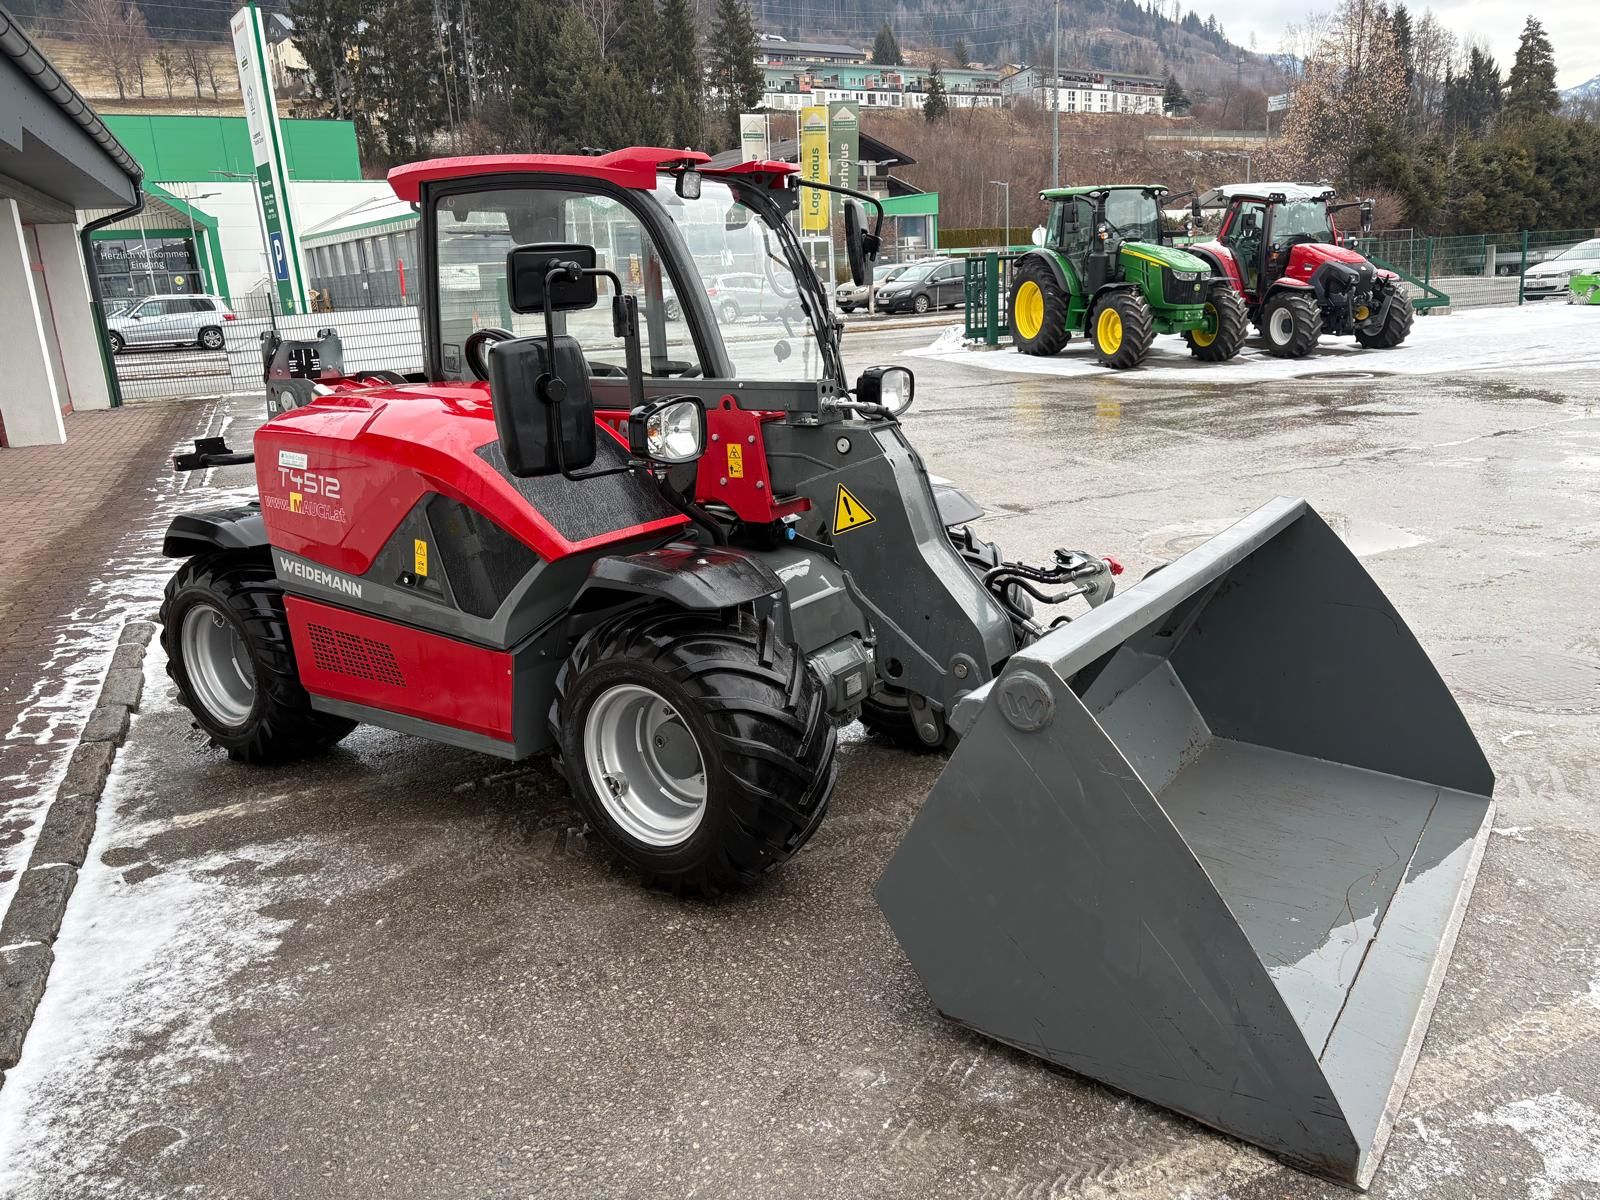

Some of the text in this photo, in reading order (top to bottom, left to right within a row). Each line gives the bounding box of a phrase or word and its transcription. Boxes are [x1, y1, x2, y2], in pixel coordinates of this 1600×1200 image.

[808, 147, 821, 216] Lagehaus
[101, 251, 136, 261] Herzlich
[273, 239, 284, 274] P
[278, 467, 341, 499] T4512
[279, 556, 362, 599] WEIDEMANN
